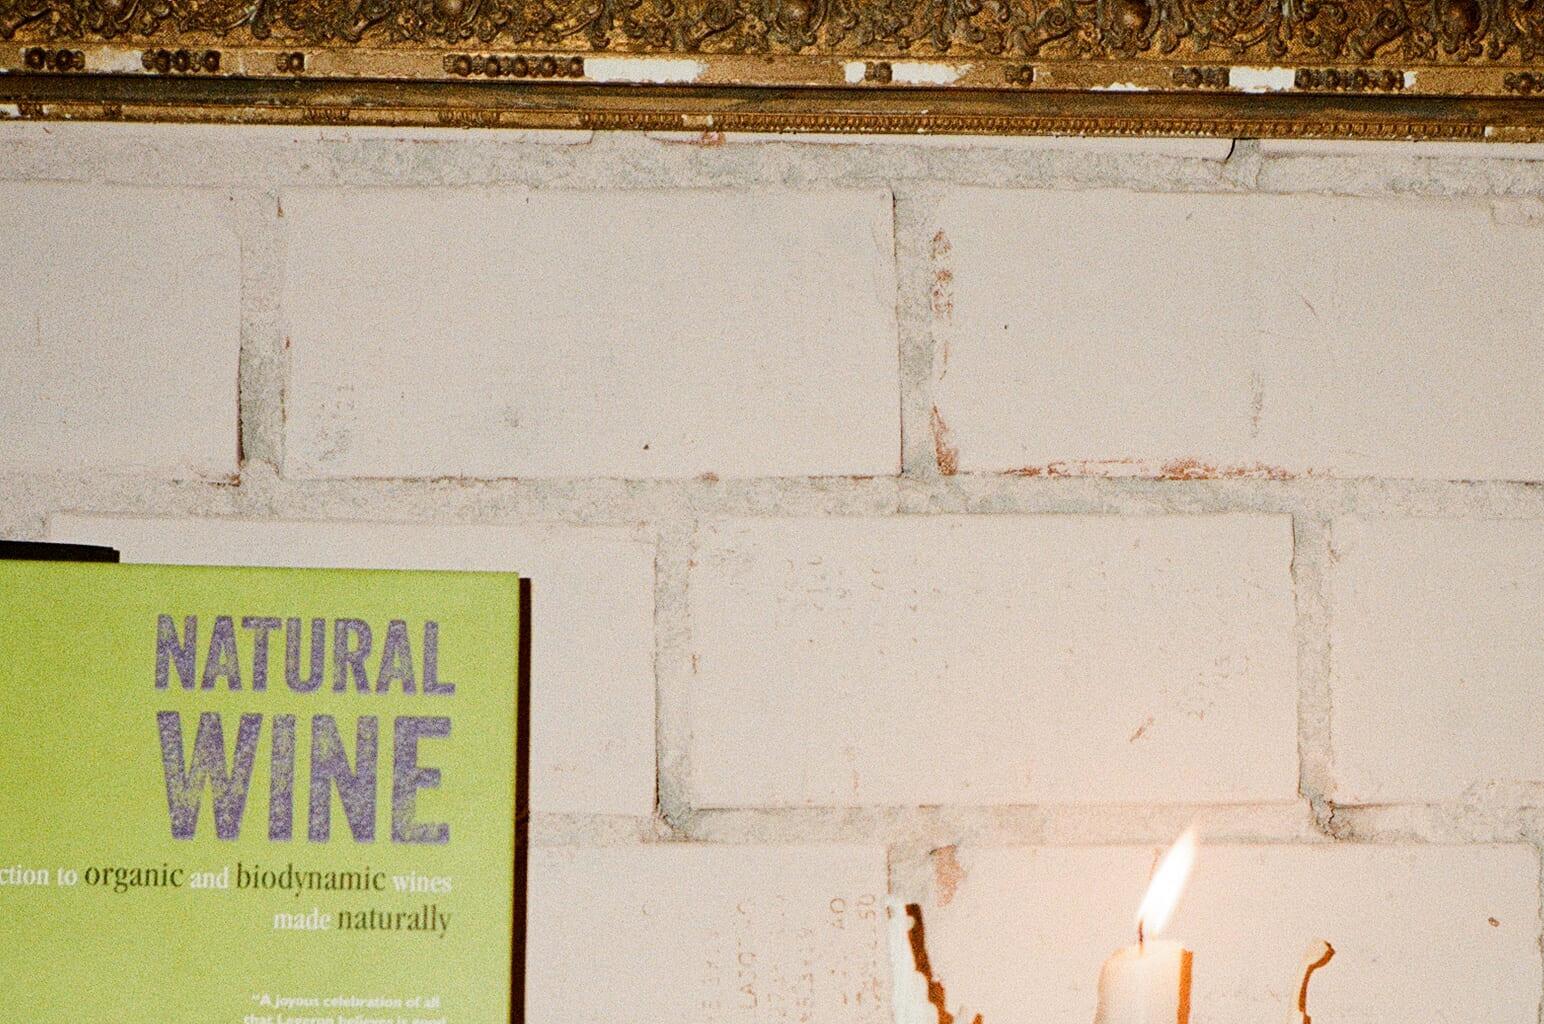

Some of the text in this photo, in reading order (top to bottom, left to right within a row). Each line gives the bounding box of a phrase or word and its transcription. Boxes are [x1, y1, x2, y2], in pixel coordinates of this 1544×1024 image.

[154, 613, 455, 695] NATURAL
[156, 711, 452, 845] WINE
[57, 866, 78, 887] to
[84, 863, 184, 893] organic
[191, 867, 230, 890] and
[236, 863, 386, 897] biodynamic
[392, 870, 451, 893] wines
[273, 904, 451, 938] made naturally
[275, 995, 320, 1009] joyous
[323, 995, 402, 1009] celebration
[405, 996, 421, 1009] of
[424, 996, 441, 1009] all
